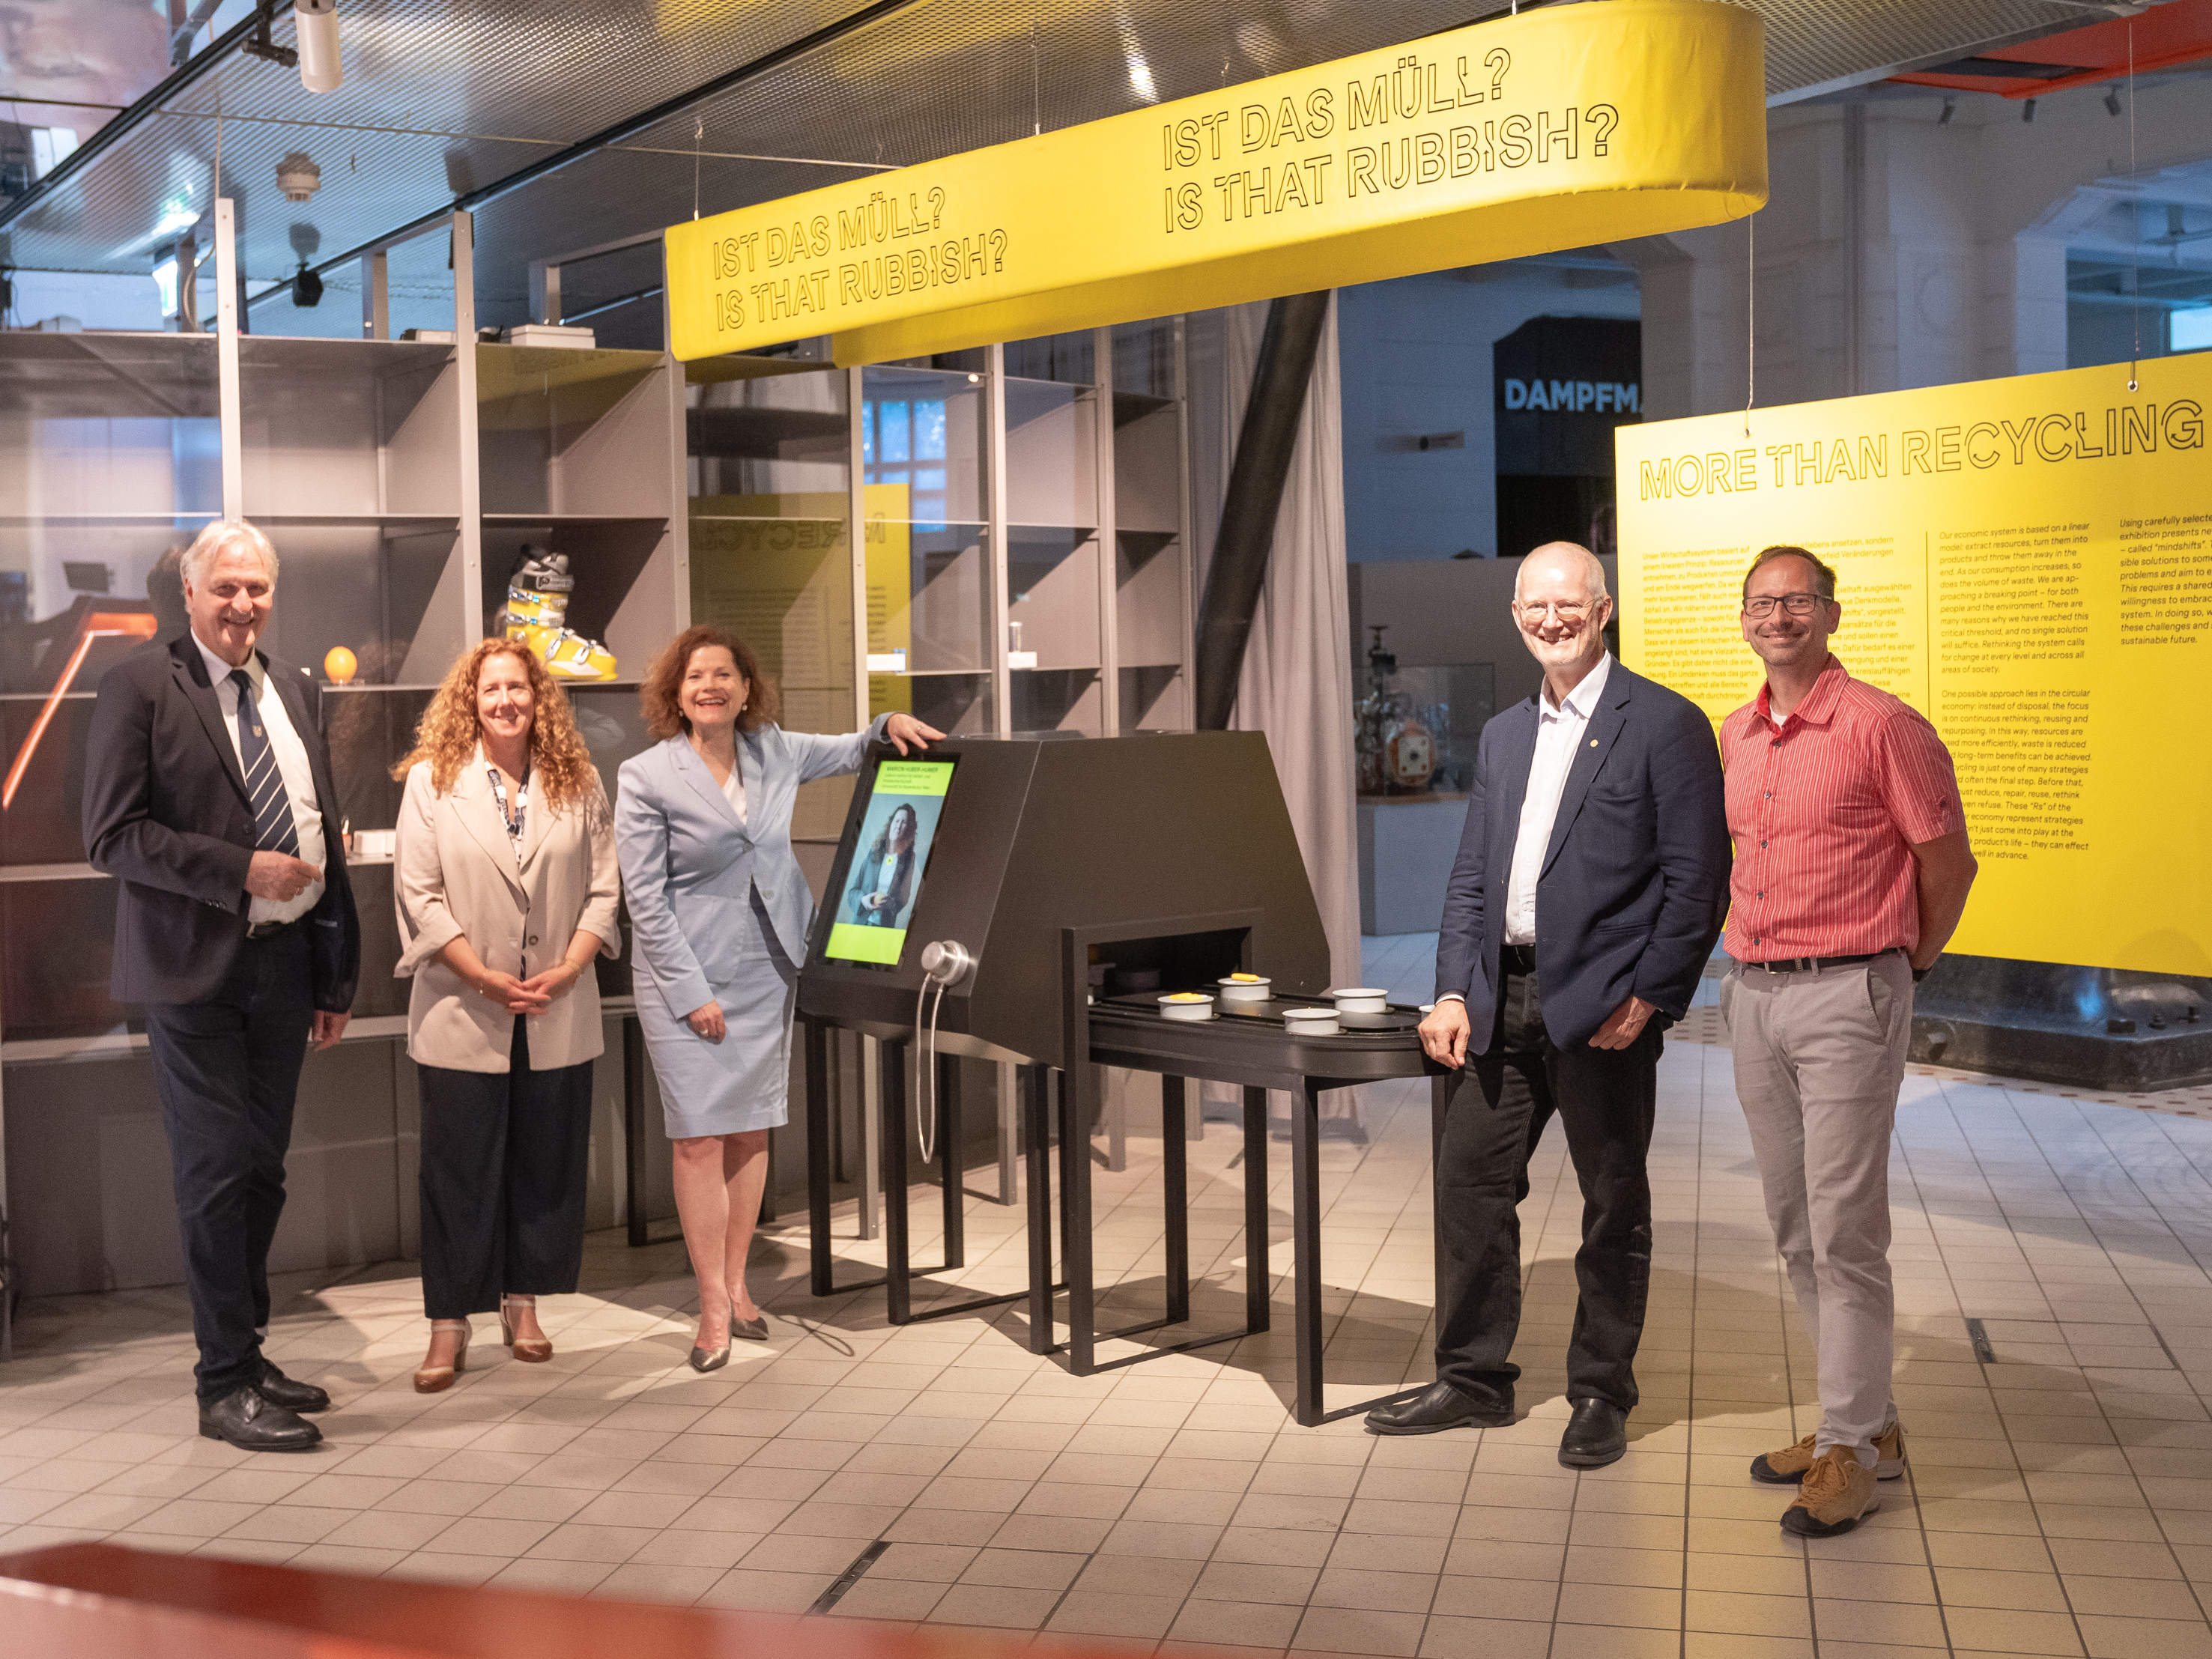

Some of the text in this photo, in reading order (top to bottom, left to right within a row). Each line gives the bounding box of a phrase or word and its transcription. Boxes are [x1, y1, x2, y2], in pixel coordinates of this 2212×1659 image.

[1164, 47, 1511, 170] IST DAS MÜLL?
[1166, 103, 1619, 233] IS THAT RUBBISH?
[714, 186, 945, 279] IST DAS MÜLL?
[716, 229, 1007, 331] IS THAT RUBBISH?
[1640, 399, 2204, 500] MORE THAN RECYCLING
[2119, 515, 2212, 527] Using carefully selecte
[1954, 530, 1988, 539] economic
[1990, 528, 2016, 537] system
[2025, 524, 2049, 533] based
[2067, 523, 2088, 531] linear
[2119, 531, 2160, 540] exhibition
[2161, 529, 2199, 539] presents
[1965, 542, 1991, 550] extract
[2127, 544, 2152, 553] called
[1939, 555, 1972, 565] products
[1974, 553, 1987, 562] and
[1989, 553, 2011, 561] throw
[2012, 551, 2031, 559] them
[2120, 558, 2139, 566] sible
[2141, 557, 2178, 565] solutions
[1981, 565, 2029, 574] consumption
[2120, 571, 2158, 581] problems
[2160, 569, 2176, 577] and
[2121, 584, 2137, 592] This
[2139, 583, 2173, 593] requires
[2183, 581, 2212, 589] shared
[2120, 597, 2166, 606] willingness
[1991, 615, 2006, 624] why
[2040, 613, 2072, 621] reached
[2164, 610, 2189, 618] doing
[1940, 628, 1964, 637] critical
[2031, 626, 2055, 635] single
[2121, 622, 2208, 631] these challenges and
[1981, 640, 2021, 649] Rethinking
[2022, 639, 2035, 647] the
[2037, 639, 2065, 648] system
[2121, 636, 2168, 644] sustainable
[1957, 690, 1987, 699] possible
[1989, 690, 2023, 699] approach
[2025, 689, 2037, 697] lies
[2043, 715, 2071, 724] reusing
[1995, 751, 2026, 759] benefits
[2043, 752, 2053, 760] be
